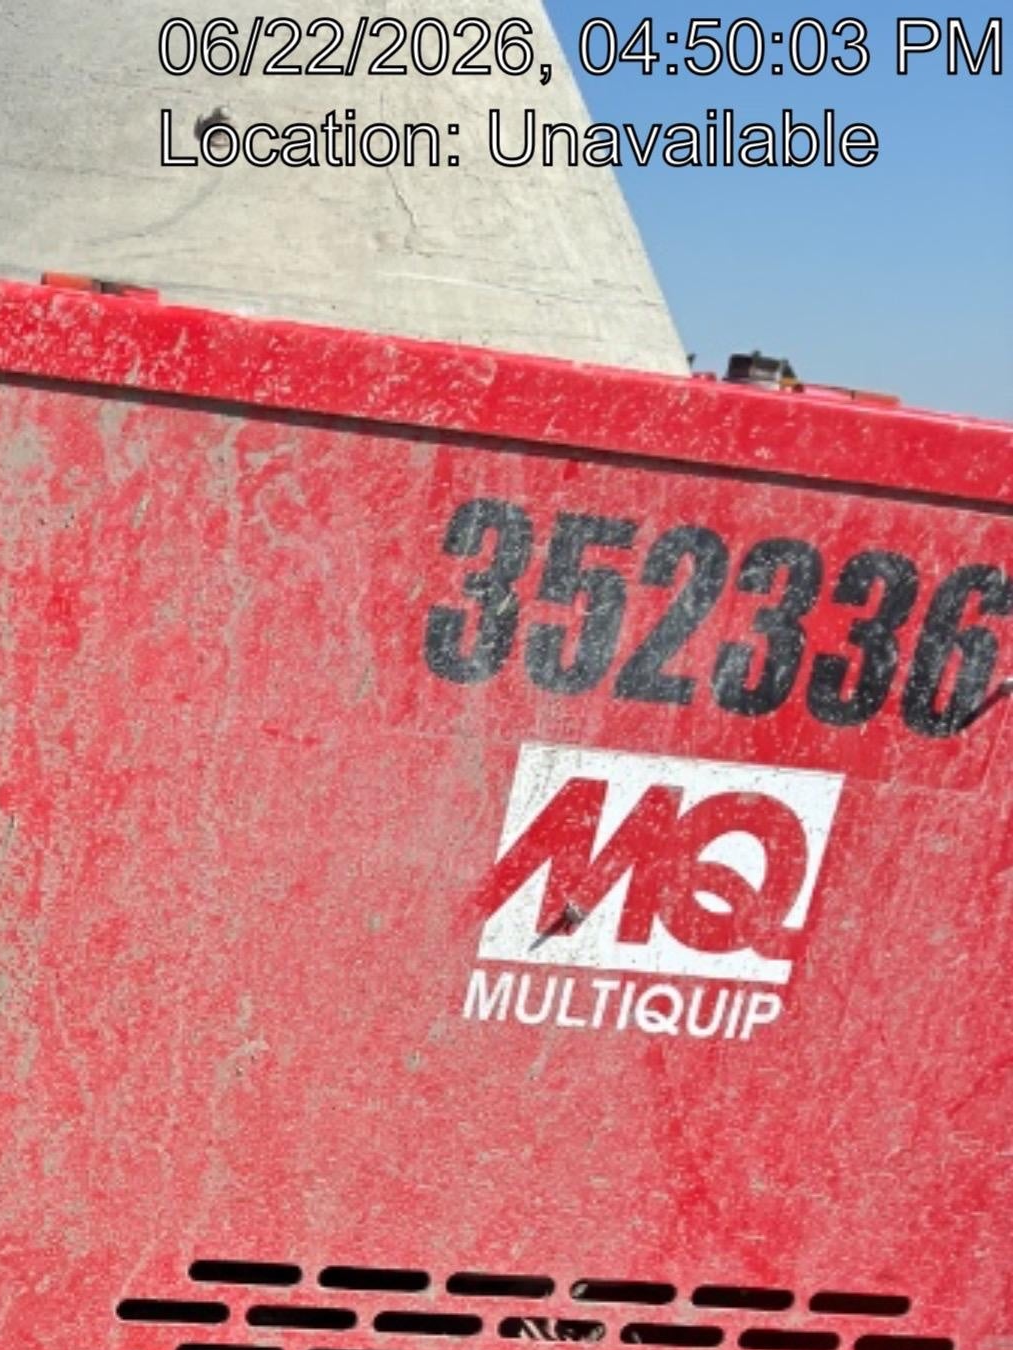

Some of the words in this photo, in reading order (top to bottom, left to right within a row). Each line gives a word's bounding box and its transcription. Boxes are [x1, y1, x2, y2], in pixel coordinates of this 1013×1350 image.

[423, 497, 1013, 740] 352336
[478, 776, 810, 956] MQ
[463, 971, 782, 1040] MULTIQUIP
